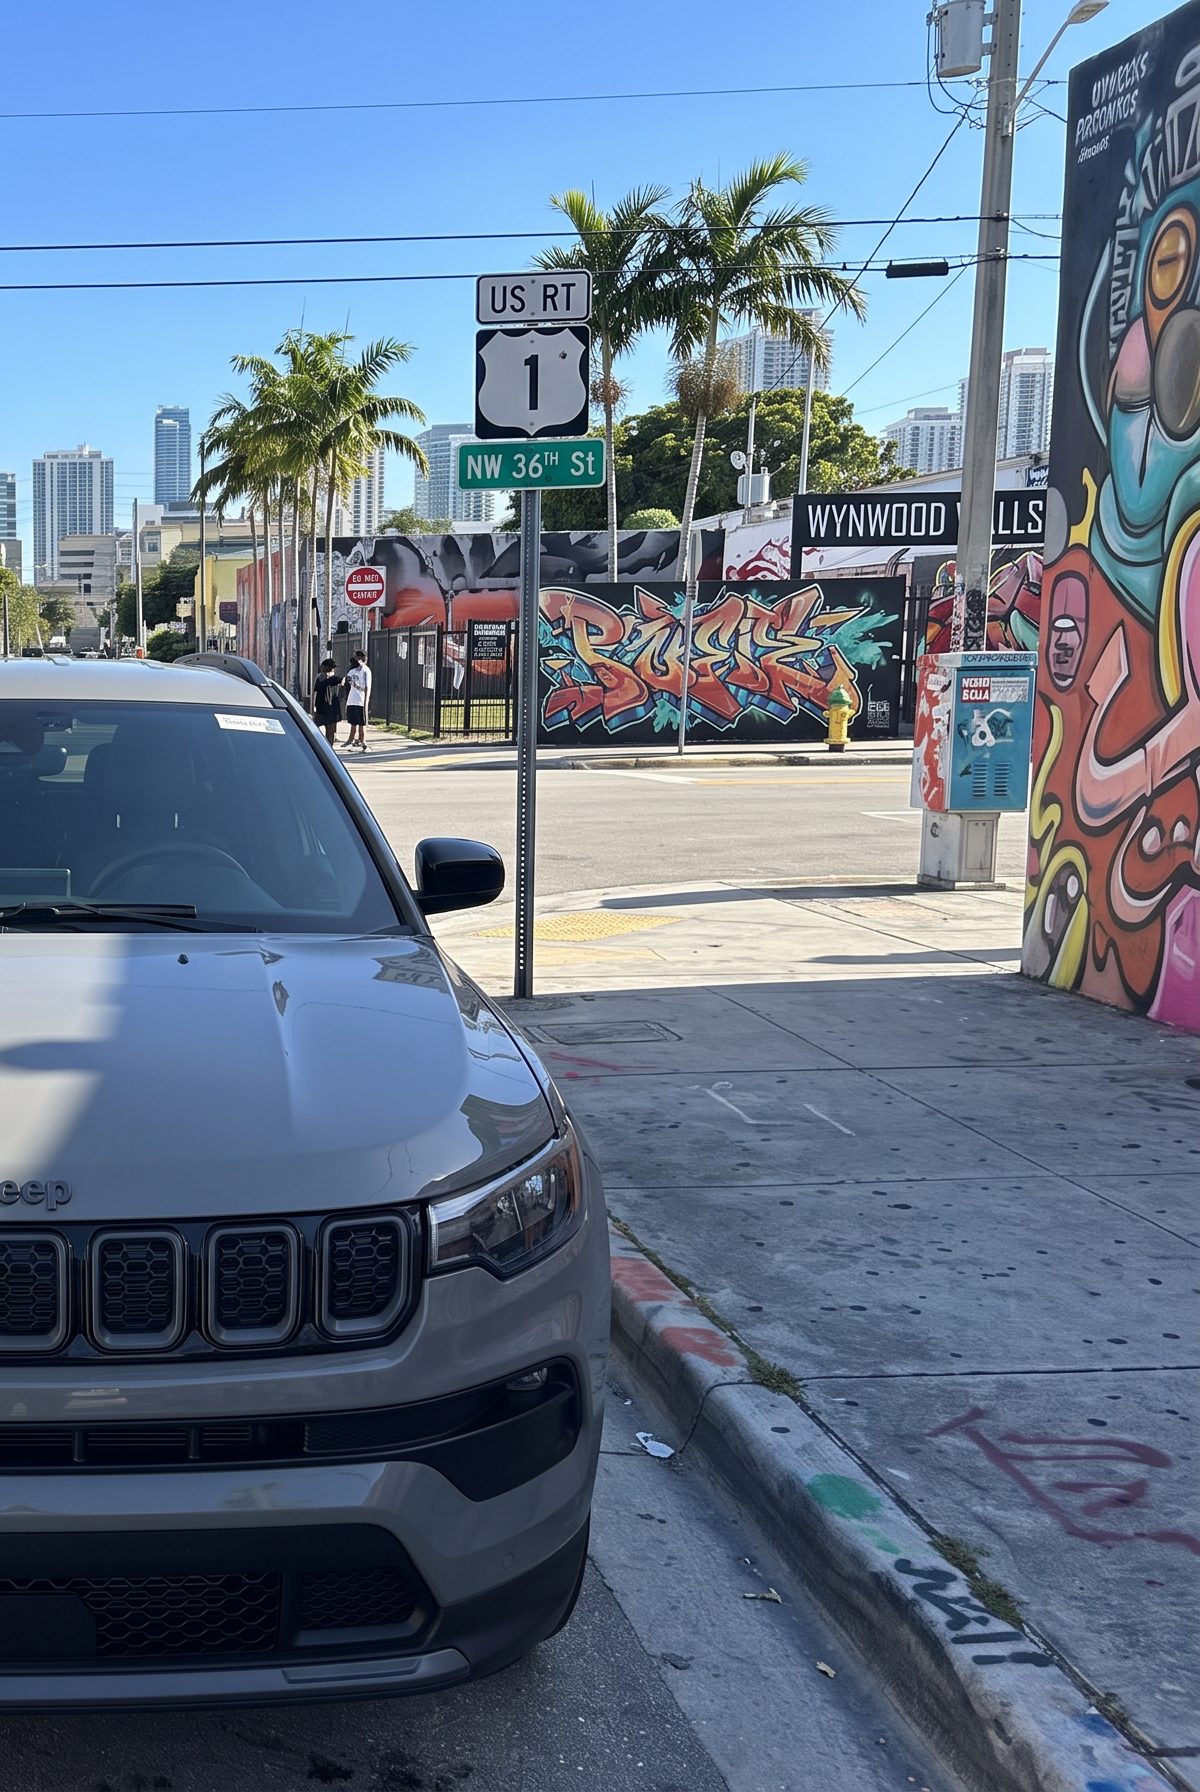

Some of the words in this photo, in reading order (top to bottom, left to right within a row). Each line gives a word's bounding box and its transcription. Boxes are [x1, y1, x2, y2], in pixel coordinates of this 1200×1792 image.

[491, 285, 526, 314] US
[542, 283, 576, 312] RT
[524, 354, 538, 411] 1
[467, 454, 503, 480] NW
[570, 451, 596, 476] St
[807, 502, 946, 538] WYNWOOD
